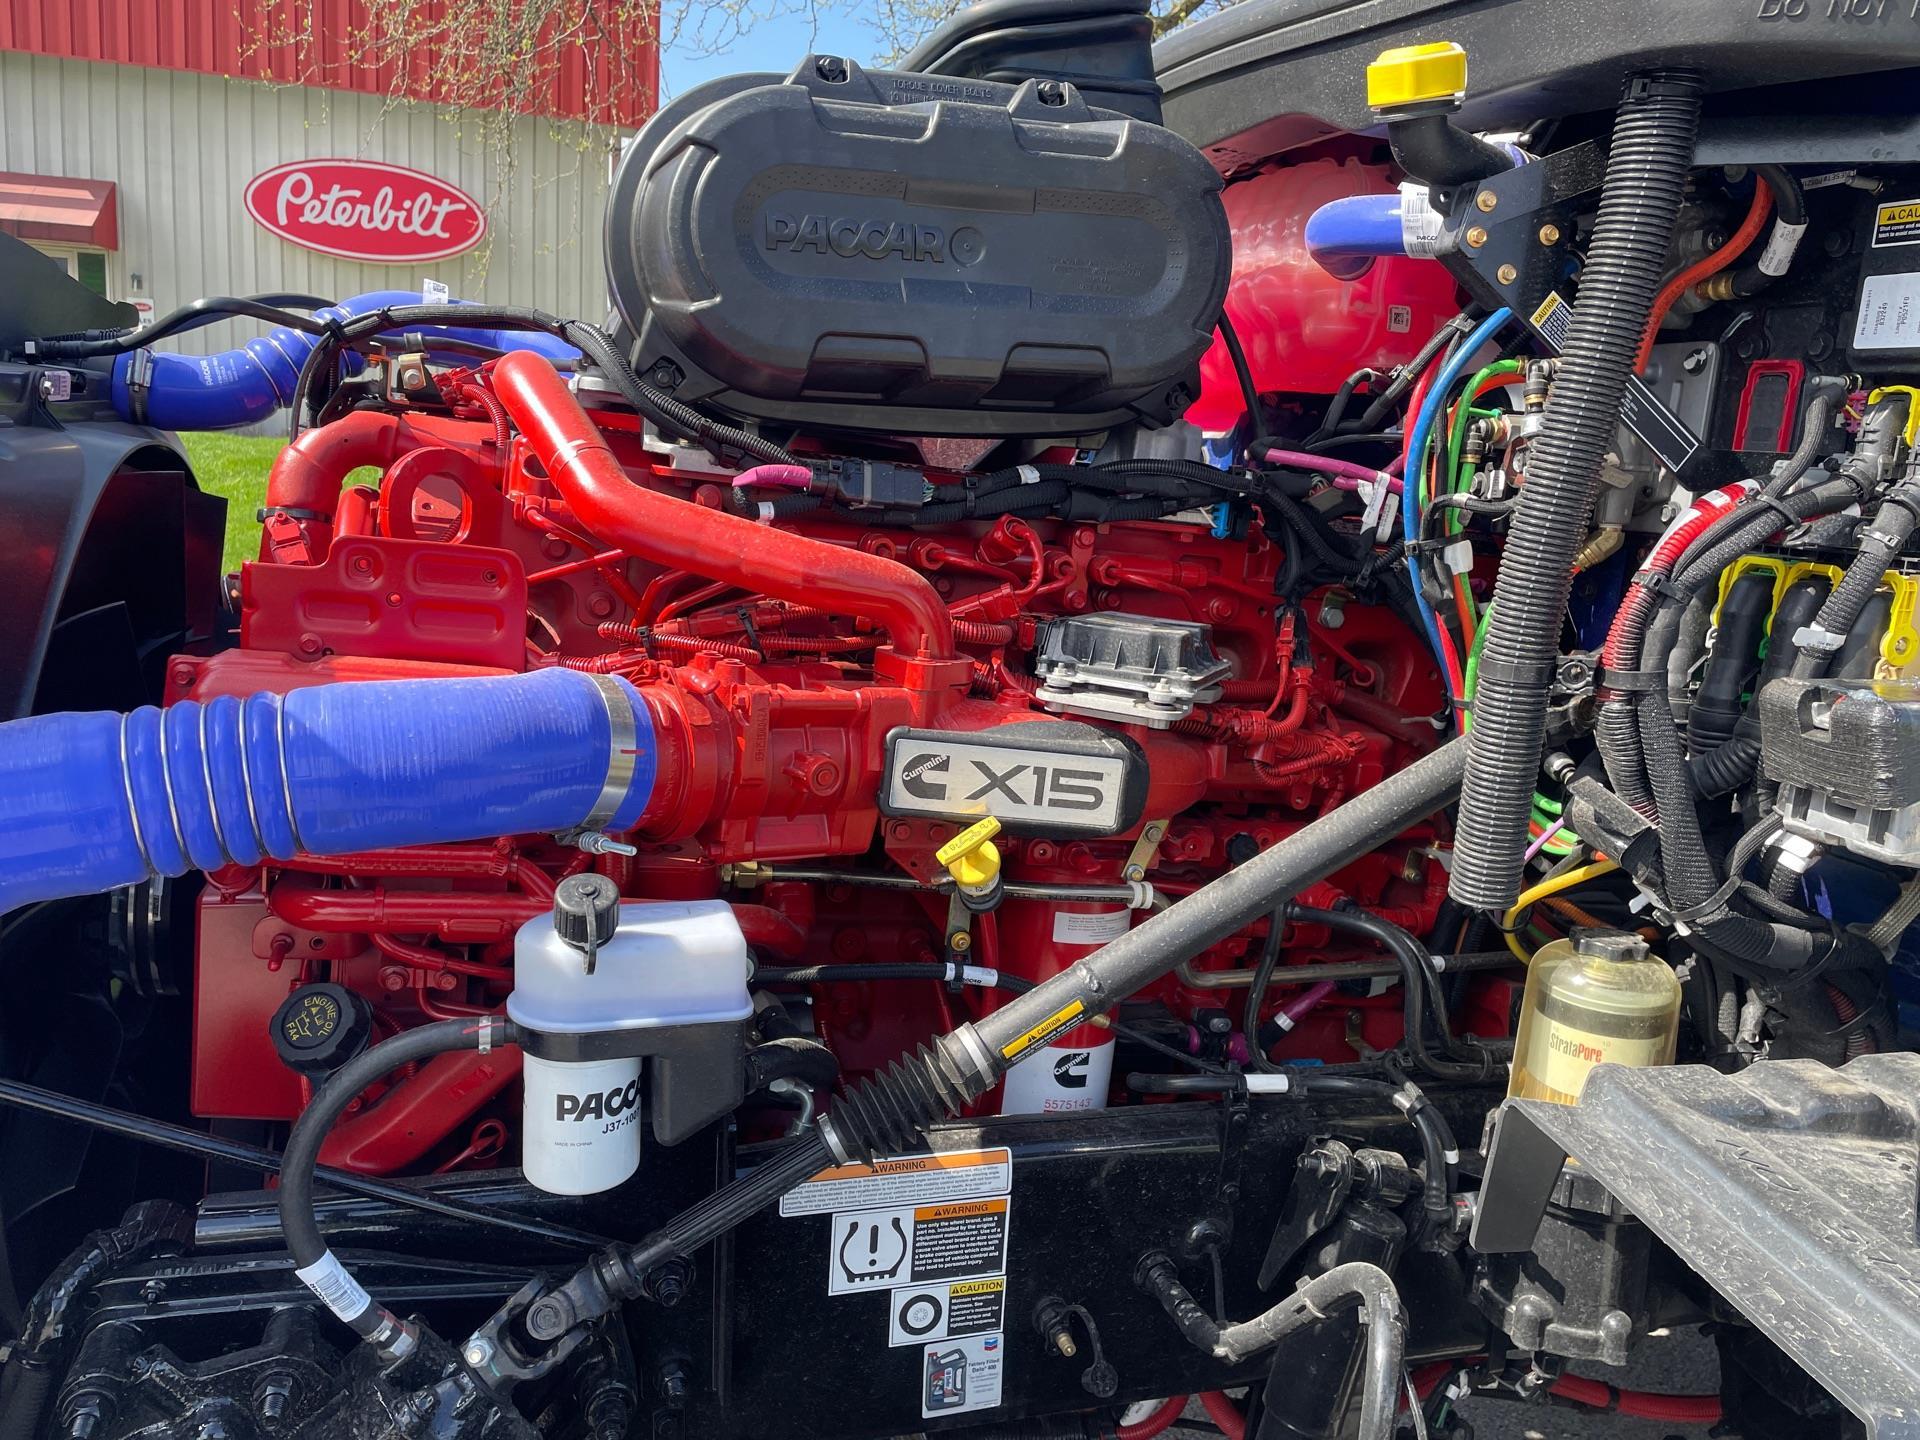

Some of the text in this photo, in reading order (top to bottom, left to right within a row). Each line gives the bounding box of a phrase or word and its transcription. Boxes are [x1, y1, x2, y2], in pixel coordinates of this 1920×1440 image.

[276, 172, 467, 238] Peterbilt
[765, 210, 945, 264] PACCAR
[1534, 296, 1558, 325] CAUTION
[902, 754, 949, 782] Cummins
[964, 760, 1105, 812] X15
[304, 997, 337, 1020] ENGINE
[286, 1022, 300, 1041] FA4
[318, 1021, 335, 1037] OIL
[1037, 1017, 1061, 1035] CAUTION
[1550, 1032, 1603, 1064] StrataPore
[1054, 1052, 1089, 1076] Cummins
[879, 1160, 927, 1173] WARNING
[943, 1203, 988, 1216] WARNING
[960, 1281, 1003, 1294] CAUTION
